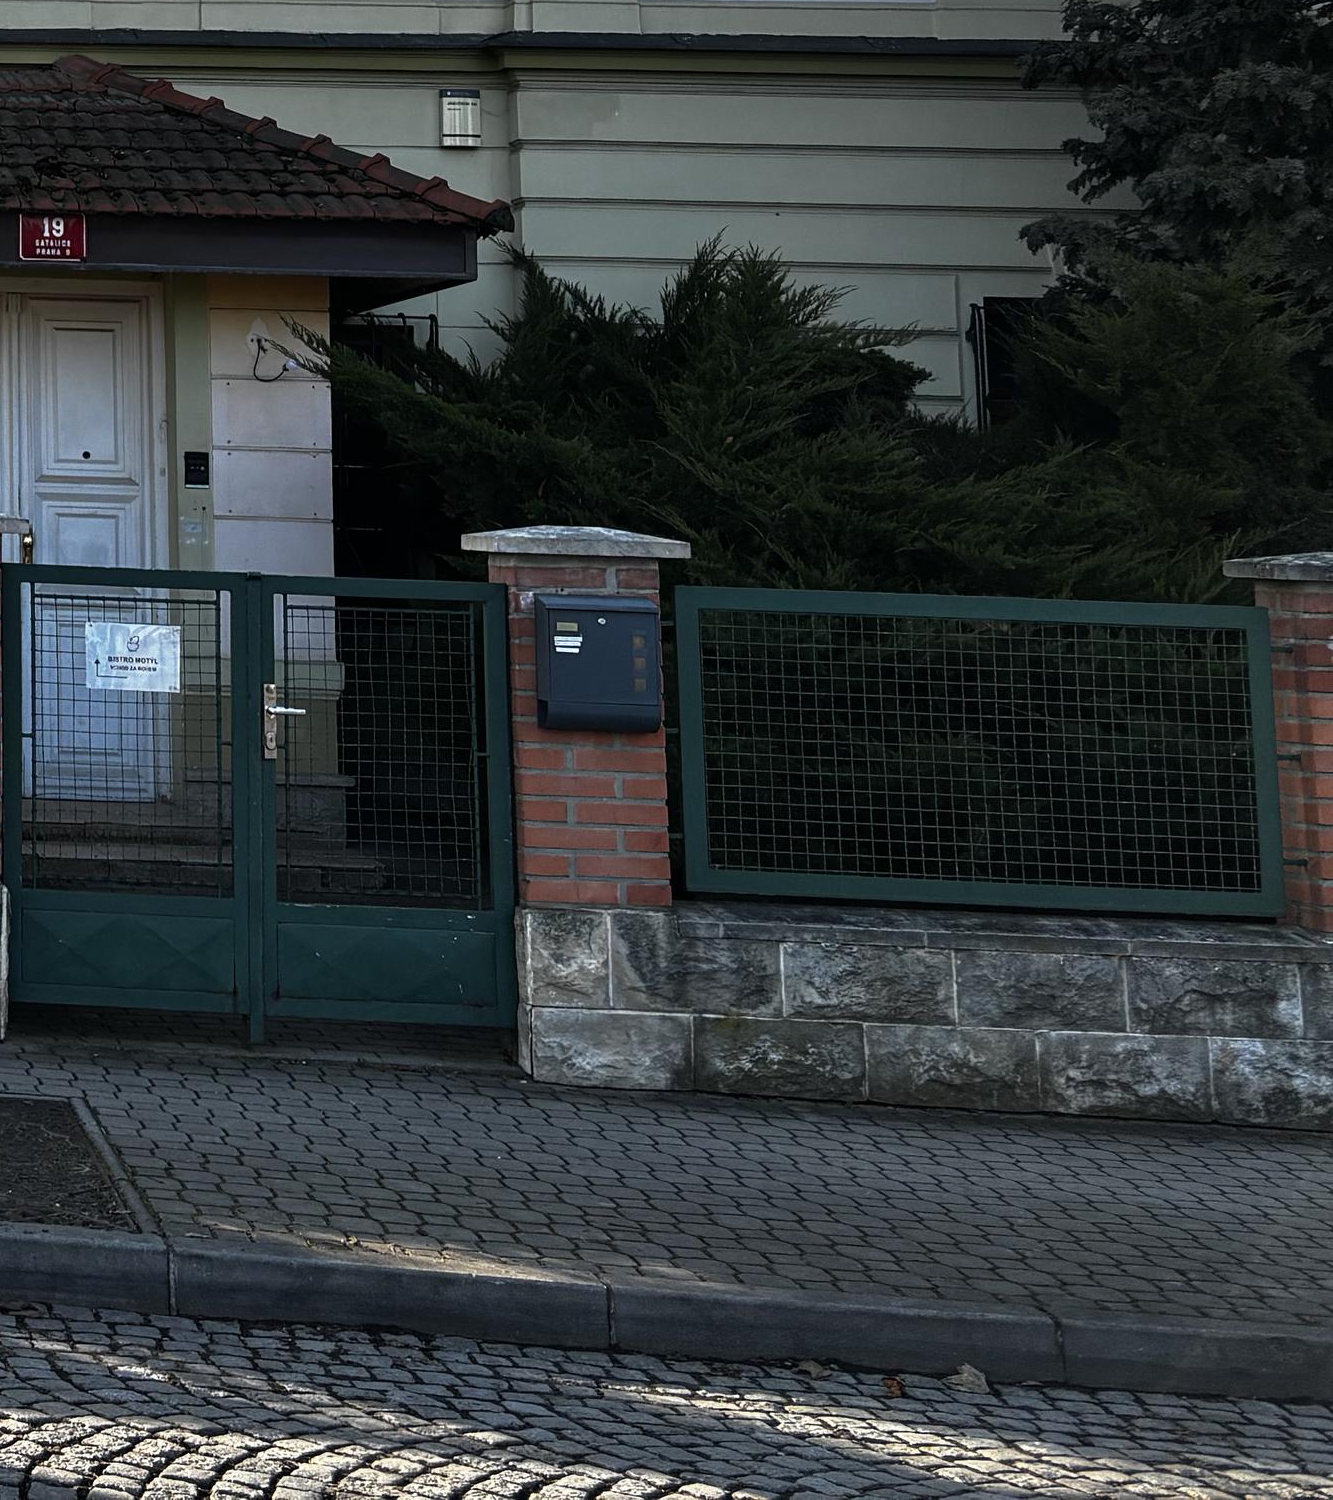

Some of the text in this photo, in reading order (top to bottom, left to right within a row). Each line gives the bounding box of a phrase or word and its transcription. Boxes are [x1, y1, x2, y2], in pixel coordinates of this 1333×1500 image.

[43, 217, 64, 238] 19
[35, 239, 71, 248] SATALICE
[36, 248, 61, 256] PRAHA
